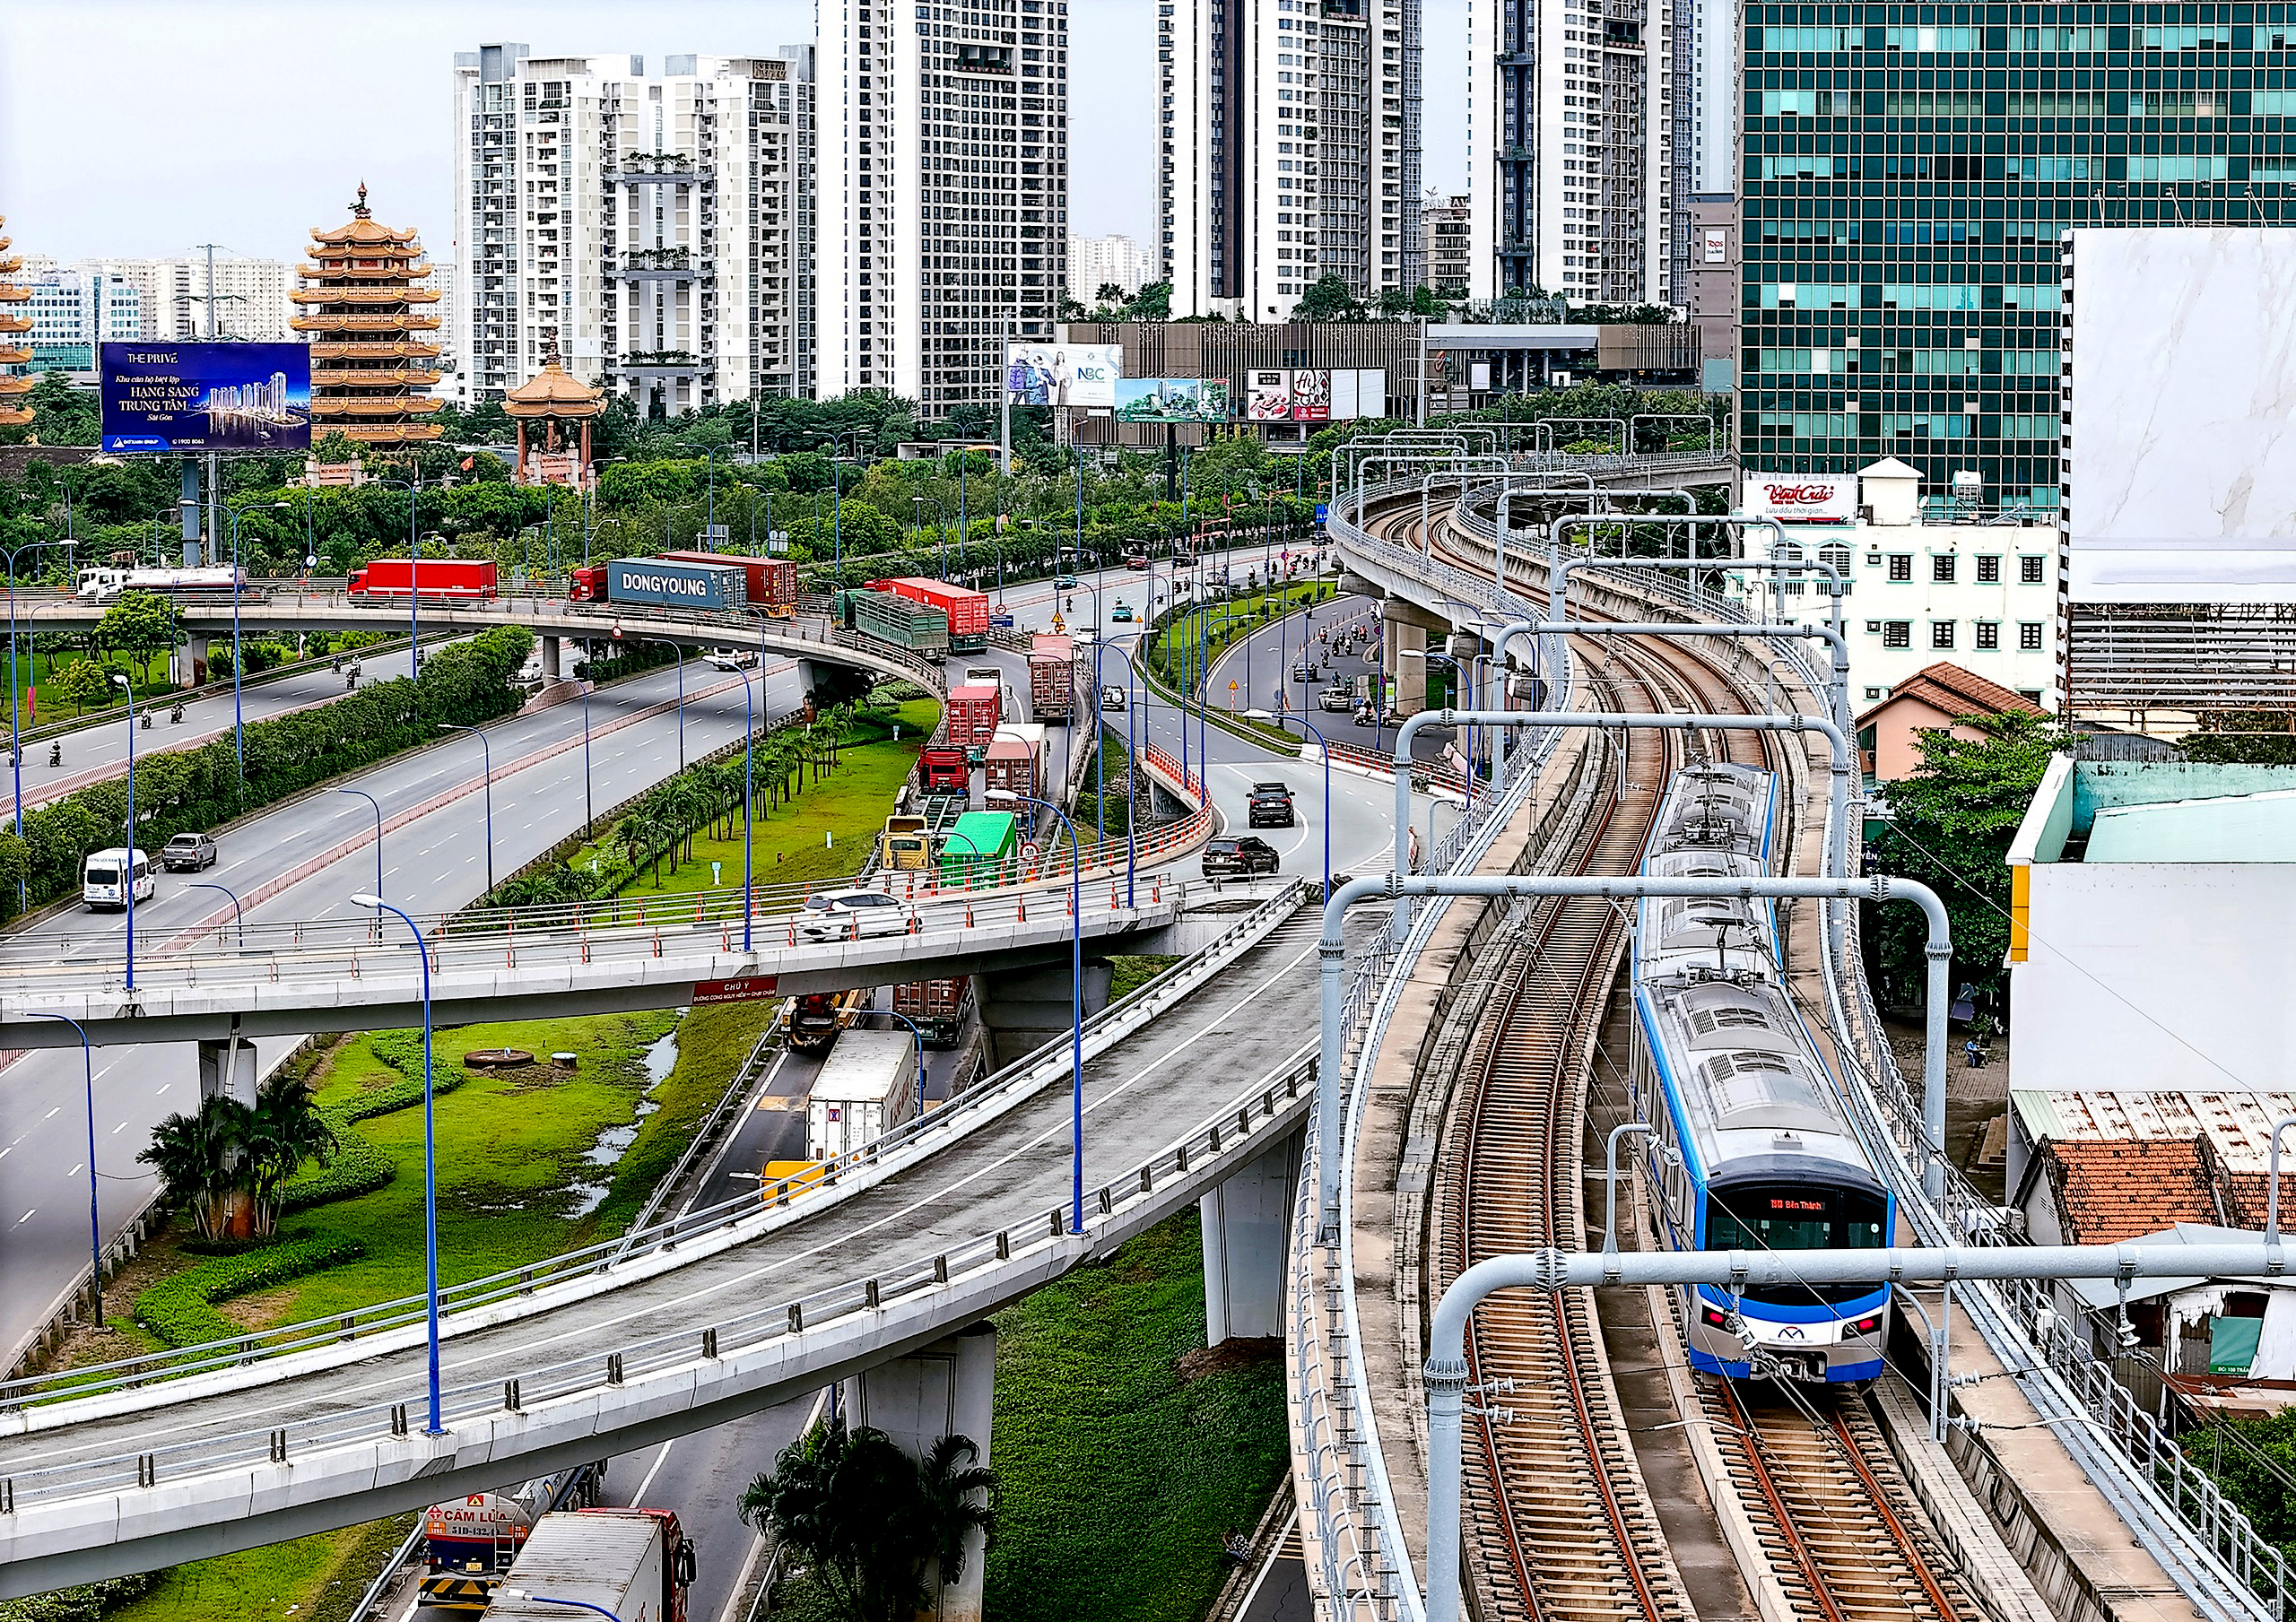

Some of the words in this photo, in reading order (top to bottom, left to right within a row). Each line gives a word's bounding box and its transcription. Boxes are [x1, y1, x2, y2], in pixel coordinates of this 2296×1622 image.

[126, 353, 145, 363] THE
[147, 352, 178, 363] PRIVÉ
[144, 376, 154, 384] hộ
[1078, 367, 1105, 380] NBC
[131, 386, 165, 399] HẠNG
[168, 386, 199, 397] SANG
[118, 400, 161, 412] TRUNG
[162, 399, 187, 411] TÂM
[622, 573, 707, 596] DONGYOUNG
[1025, 847, 1034, 855] 30
[724, 981, 742, 991] CHÚ
[744, 980, 750, 990] Ý
[443, 1508, 475, 1522] CẤM
[479, 1509, 509, 1523] LỬA
